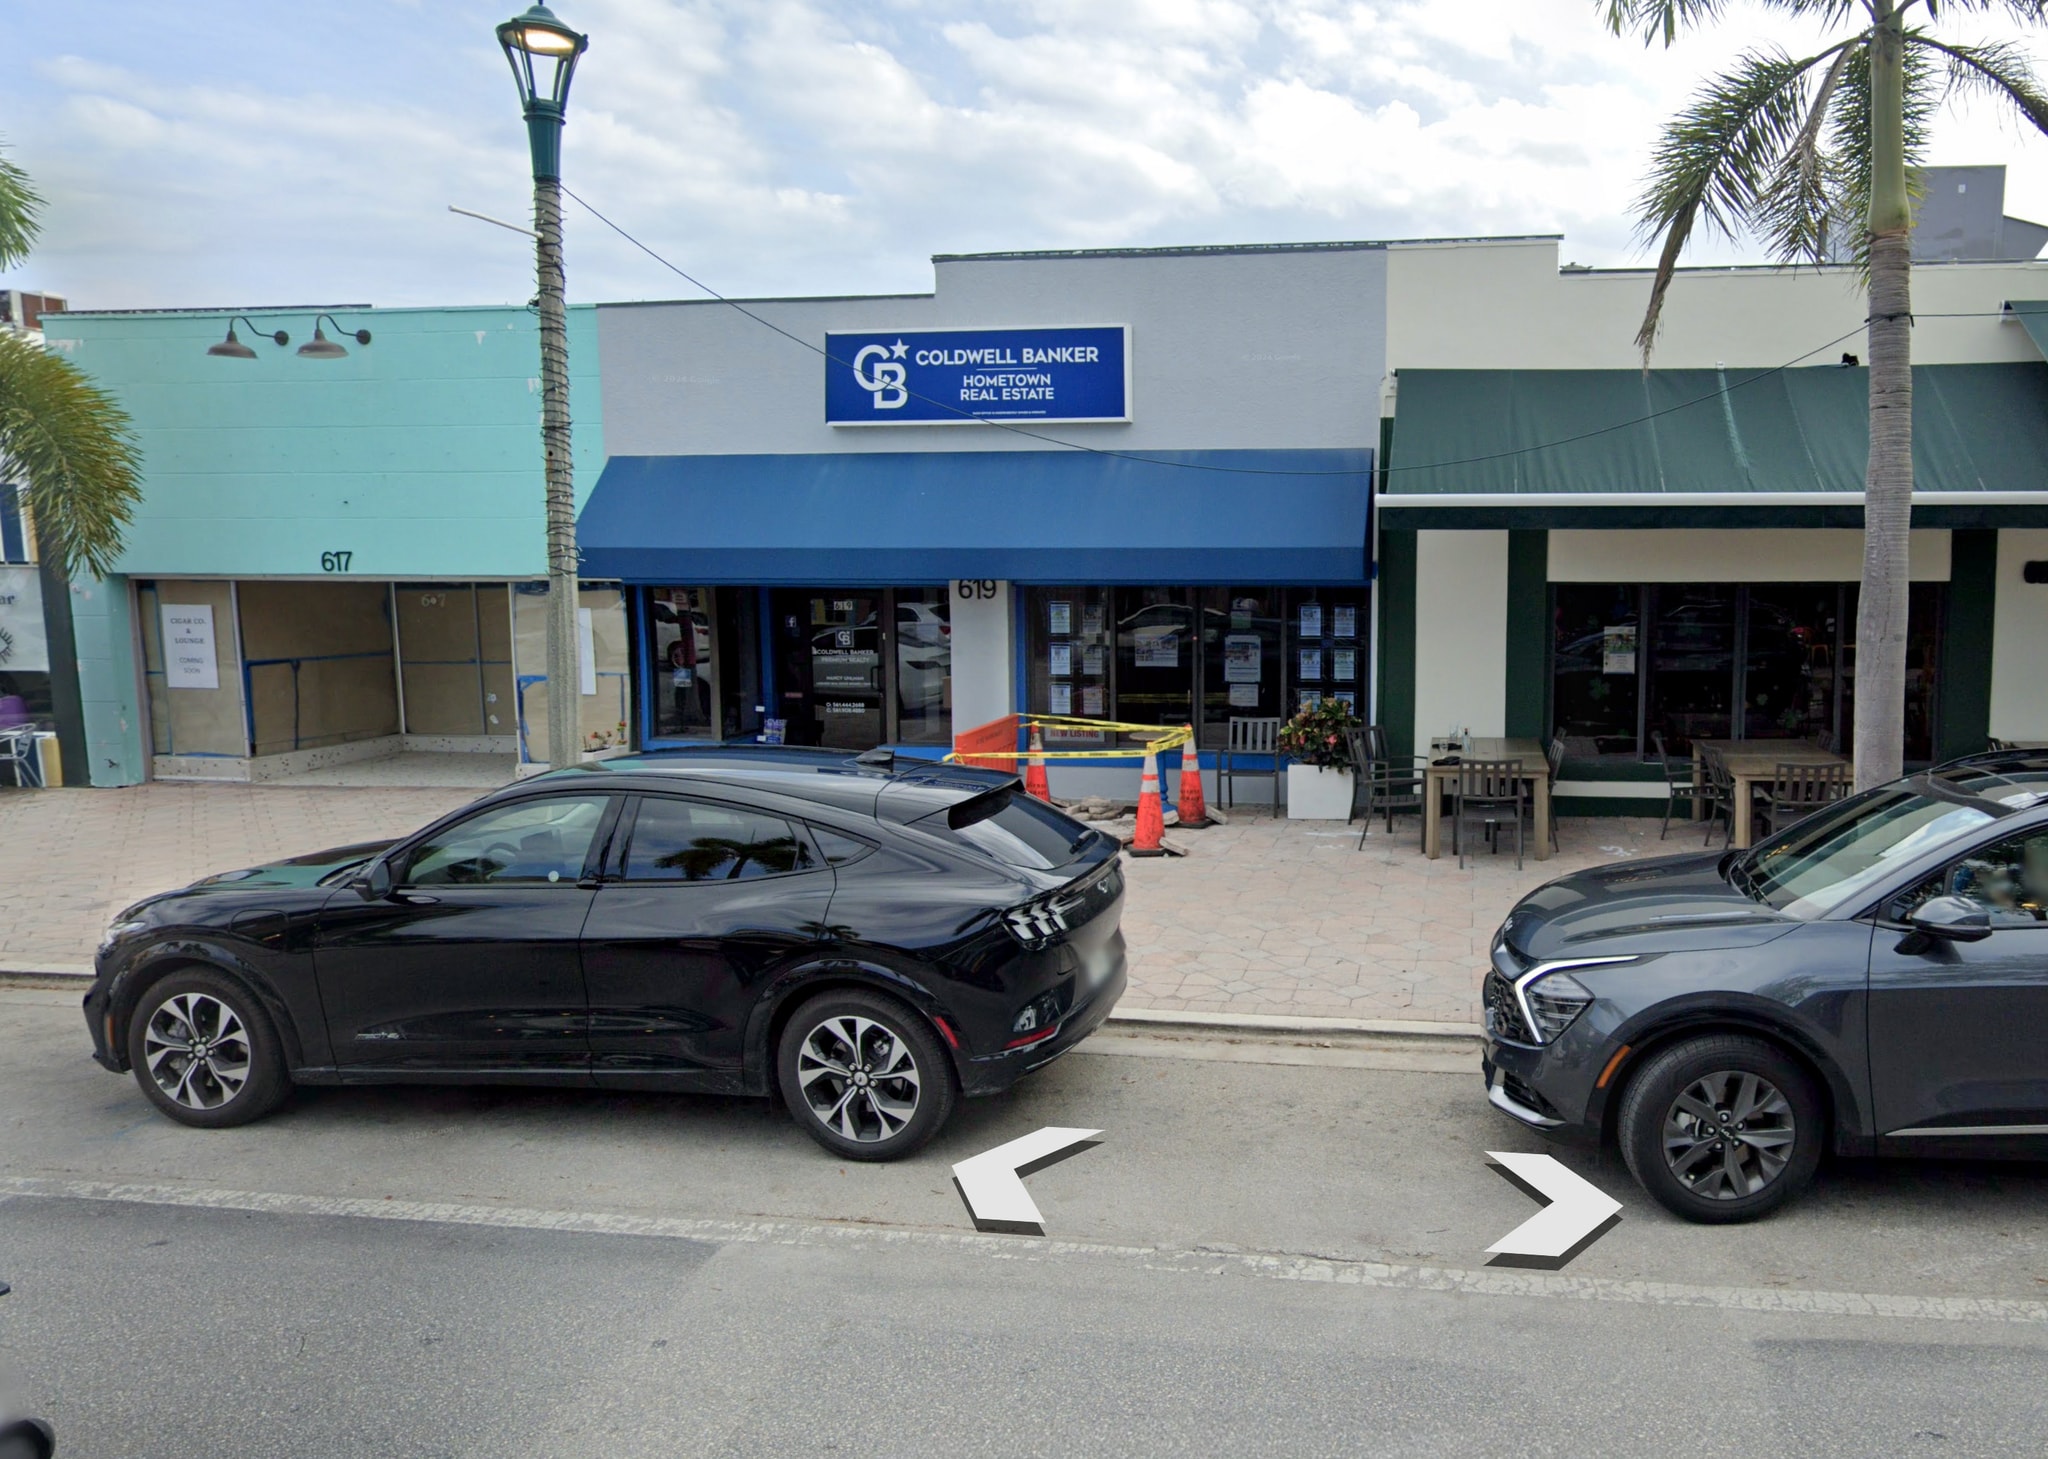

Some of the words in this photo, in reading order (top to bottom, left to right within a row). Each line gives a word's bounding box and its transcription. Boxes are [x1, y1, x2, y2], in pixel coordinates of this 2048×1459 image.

[915, 349, 1017, 367] COLDWELL
[1022, 346, 1099, 364] BANKER
[963, 373, 1051, 388] HOMETOWN
[960, 389, 998, 401] REAL
[1002, 387, 1054, 401] ESTATE
[321, 551, 352, 572] 617
[958, 579, 996, 599] 619
[421, 593, 446, 607] 67
[835, 601, 852, 610] 619
[170, 617, 192, 625] CIGAR
[193, 617, 206, 625] CO.
[1050, 729, 1067, 738] NEW
[1070, 729, 1099, 738] LISTING
